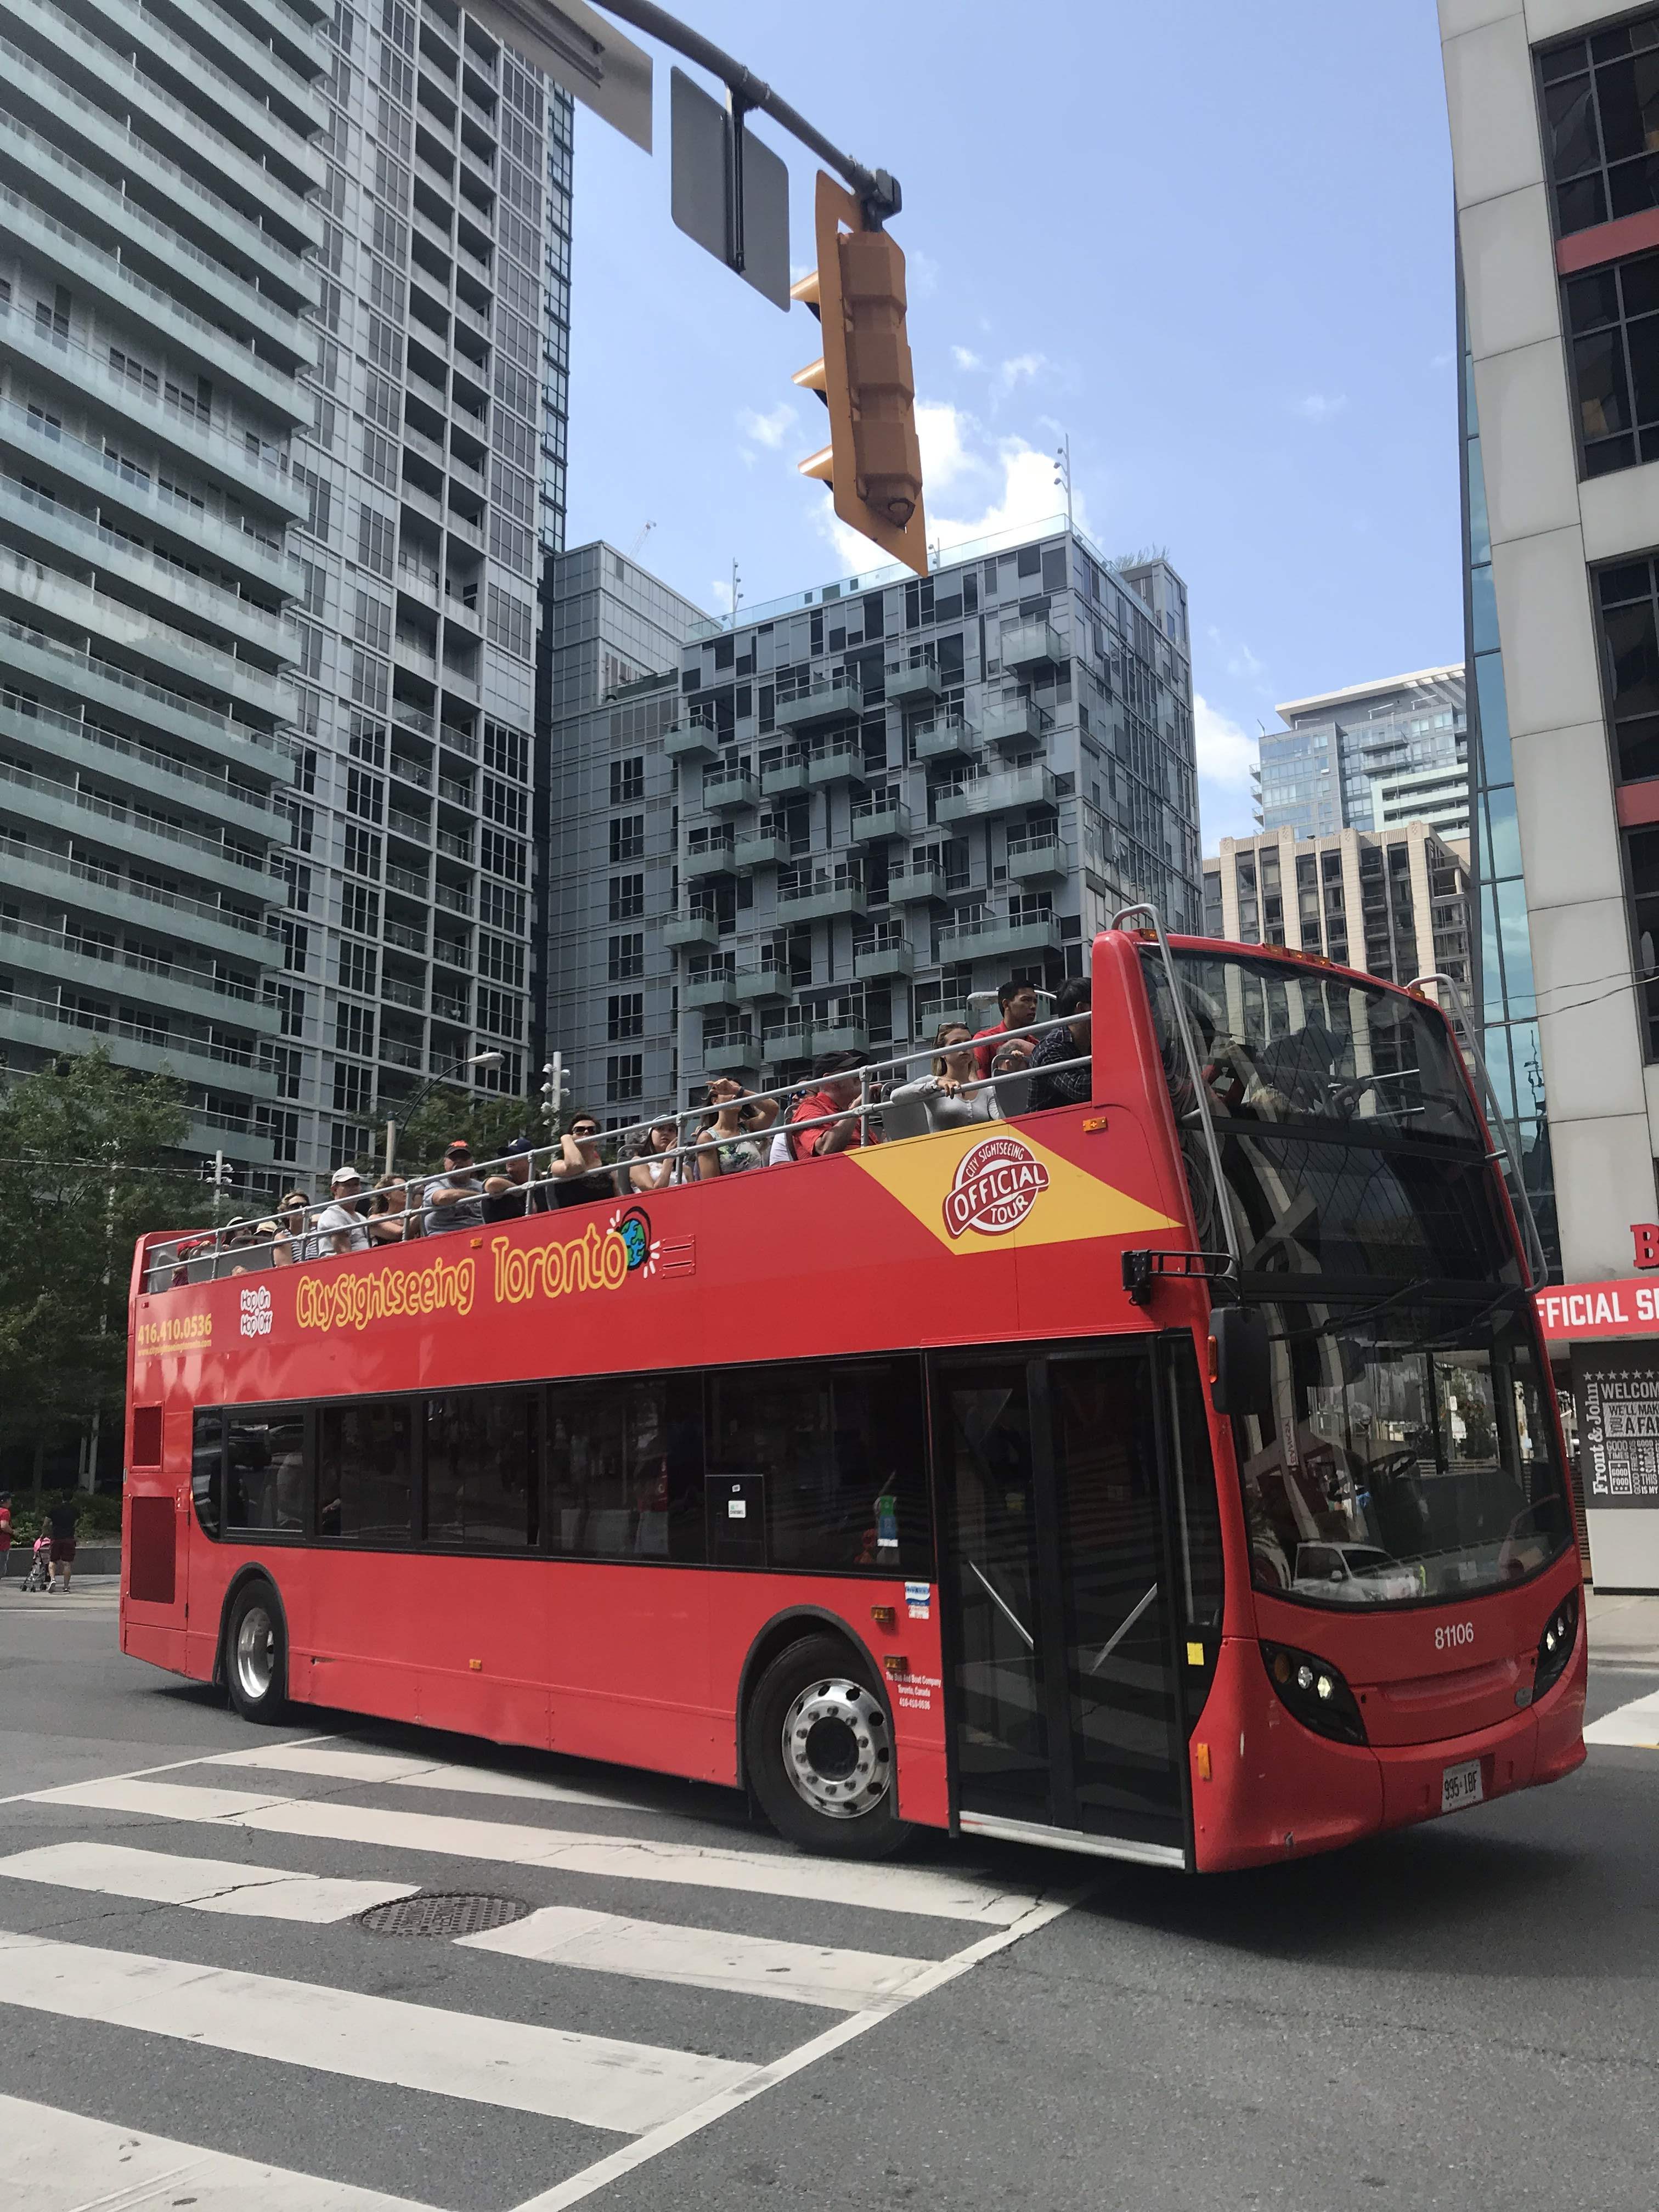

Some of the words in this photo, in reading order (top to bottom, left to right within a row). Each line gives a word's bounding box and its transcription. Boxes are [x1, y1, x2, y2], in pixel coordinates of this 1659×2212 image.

[966, 1158, 980, 1178] CITY
[978, 1142, 1024, 1163] SIGHTSEEING
[954, 1165, 1046, 1222] OFFICIAL
[990, 1194, 1029, 1224] TOUR
[491, 1222, 628, 1304] Toronto
[240, 1289, 258, 1313] Hop
[258, 1285, 270, 1310] On
[138, 1313, 212, 1345] 416.410.0536
[240, 1313, 258, 1338] Hop
[258, 1310, 273, 1335] Off
[1585, 1383, 1601, 1425] John
[1588, 1426, 1603, 1442] &
[1606, 1440, 1628, 1452] GOOD
[1637, 1439, 1654, 1447] GOOD
[1589, 1444, 1608, 1494] Front
[1612, 1468, 1628, 1476] GOOD
[1612, 1477, 1629, 1486] FOOD
[1640, 1474, 1657, 1485] THIS
[1632, 1472, 1641, 1495] GOOD
[1649, 1486, 1658, 1494] MY
[1435, 1622, 1474, 1650] 81106
